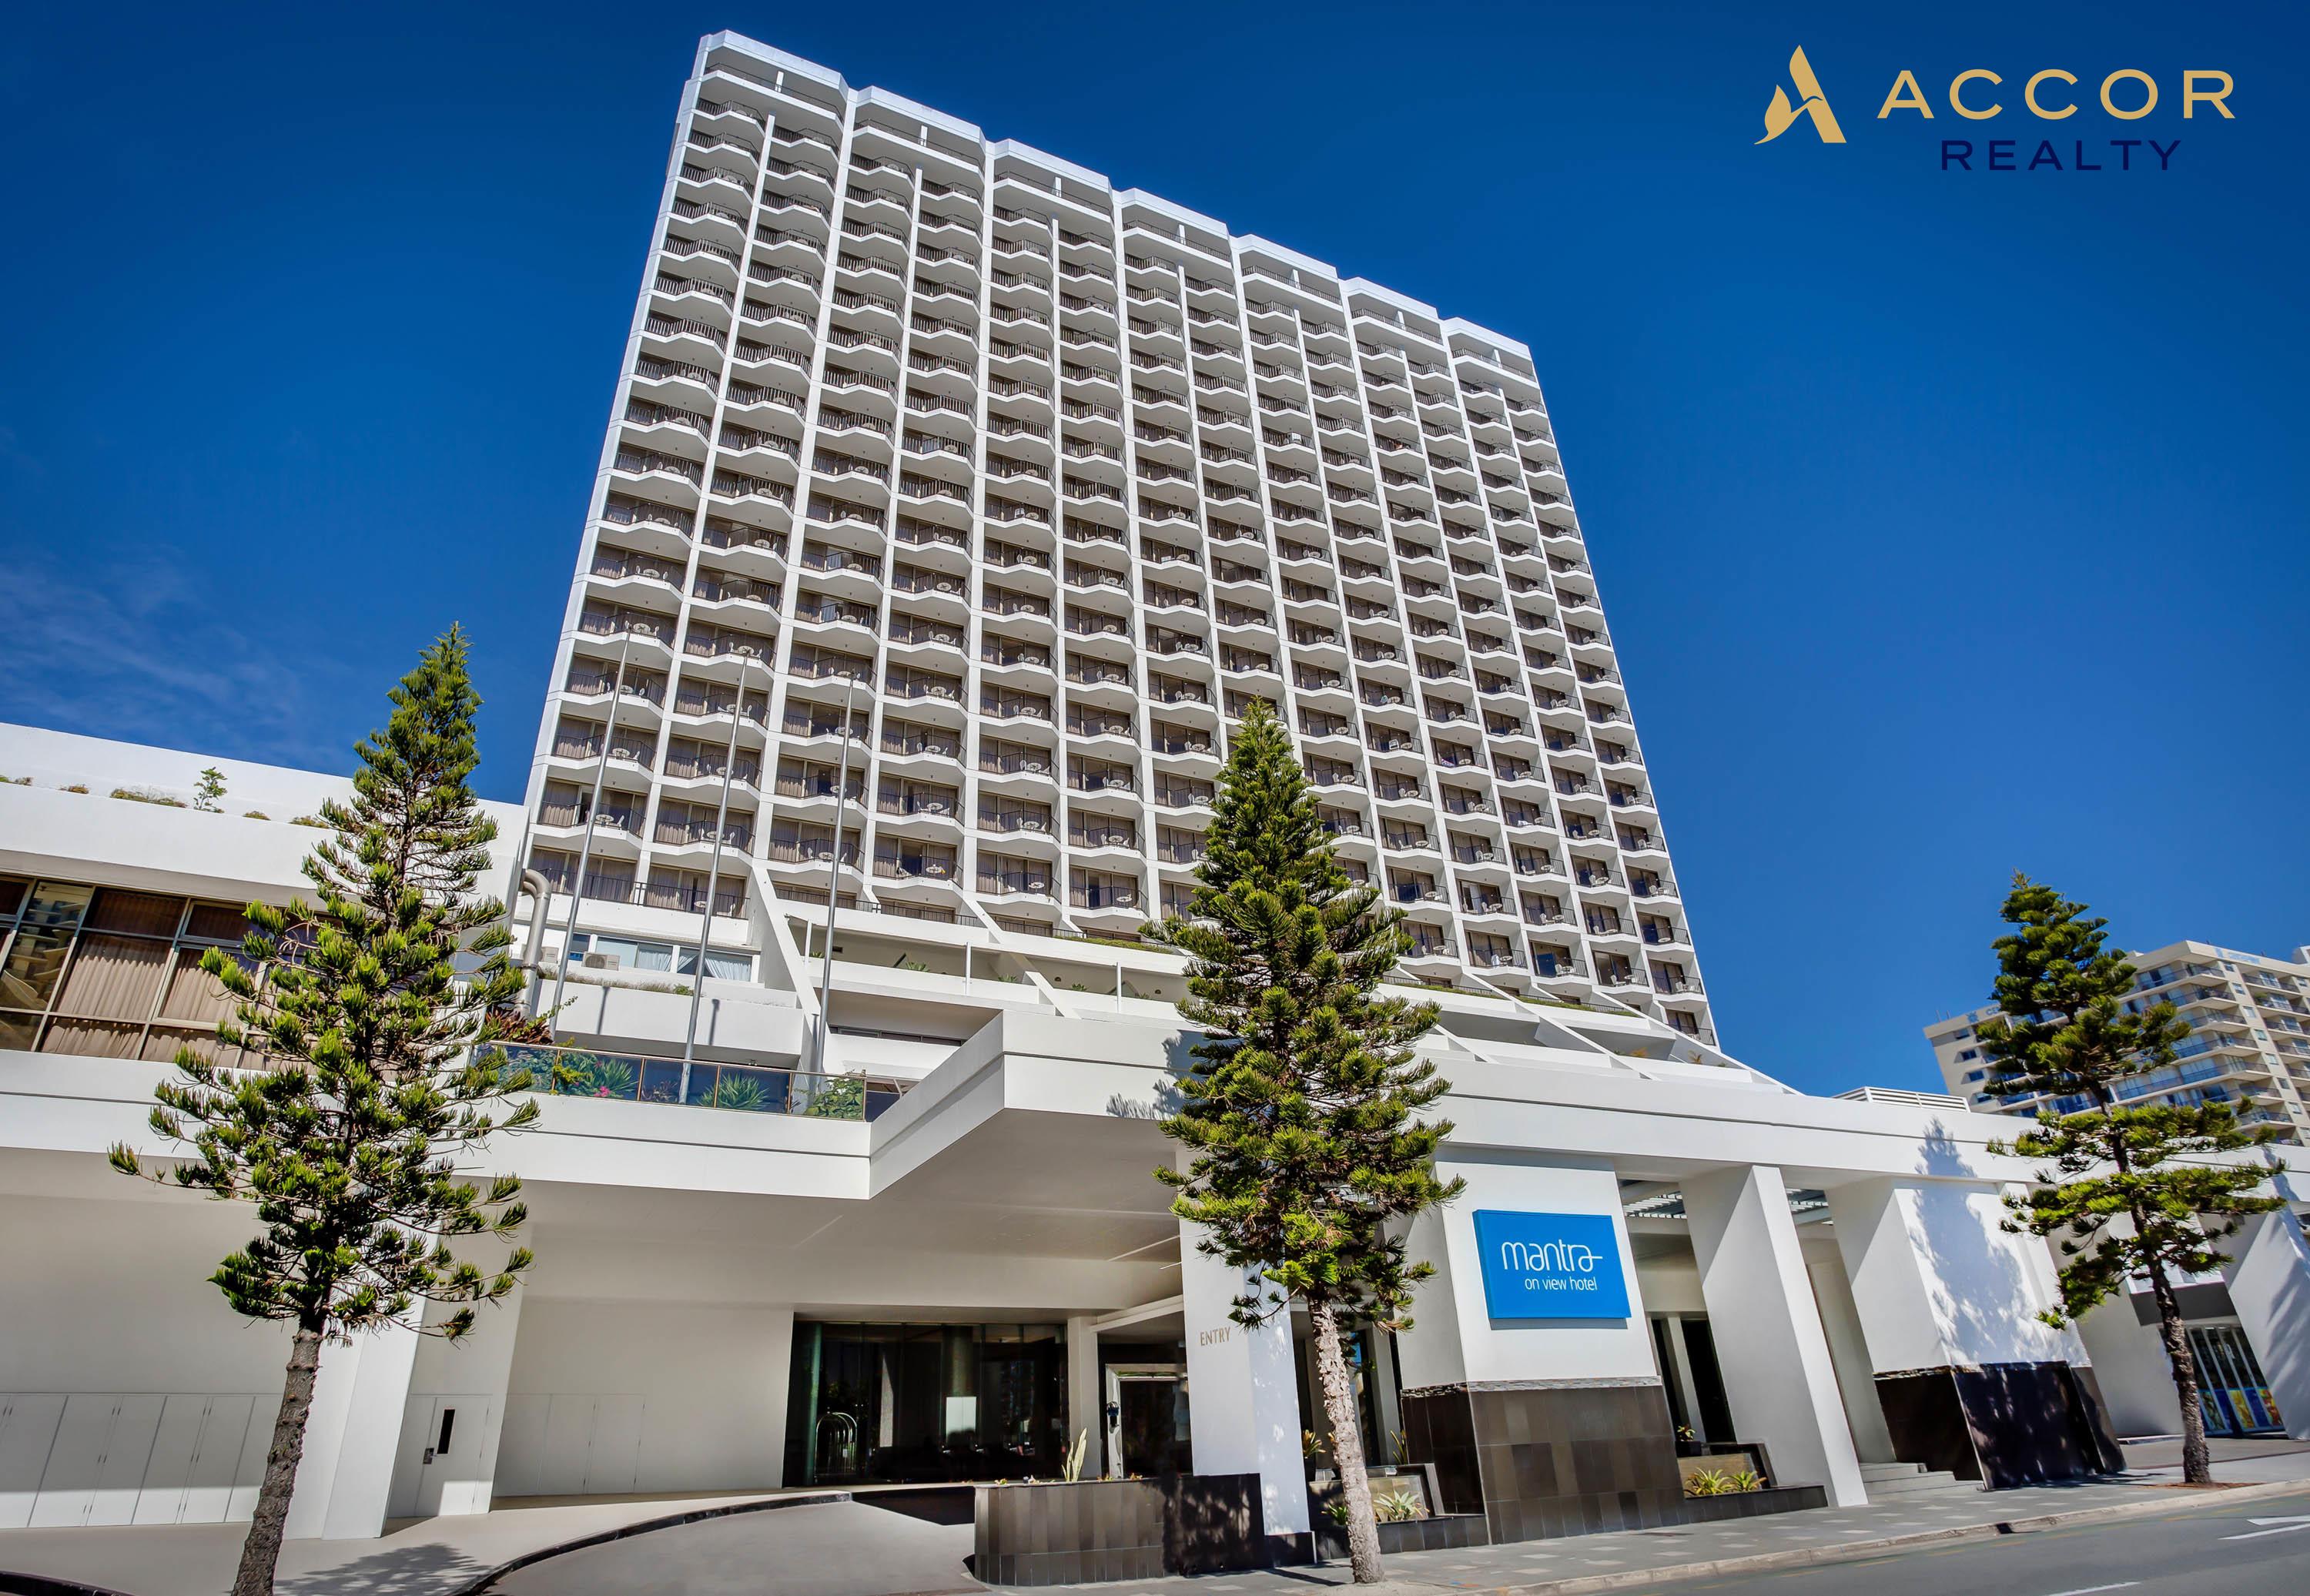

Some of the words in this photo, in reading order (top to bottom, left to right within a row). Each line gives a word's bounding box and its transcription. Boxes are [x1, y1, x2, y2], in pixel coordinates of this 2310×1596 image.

[1502, 1239, 1603, 1273] mantra
[1525, 1277, 1540, 1290] on
[1542, 1276, 1567, 1291] view
[1569, 1276, 1598, 1291] hotel
[1200, 1327, 1231, 1347] ENTRY
